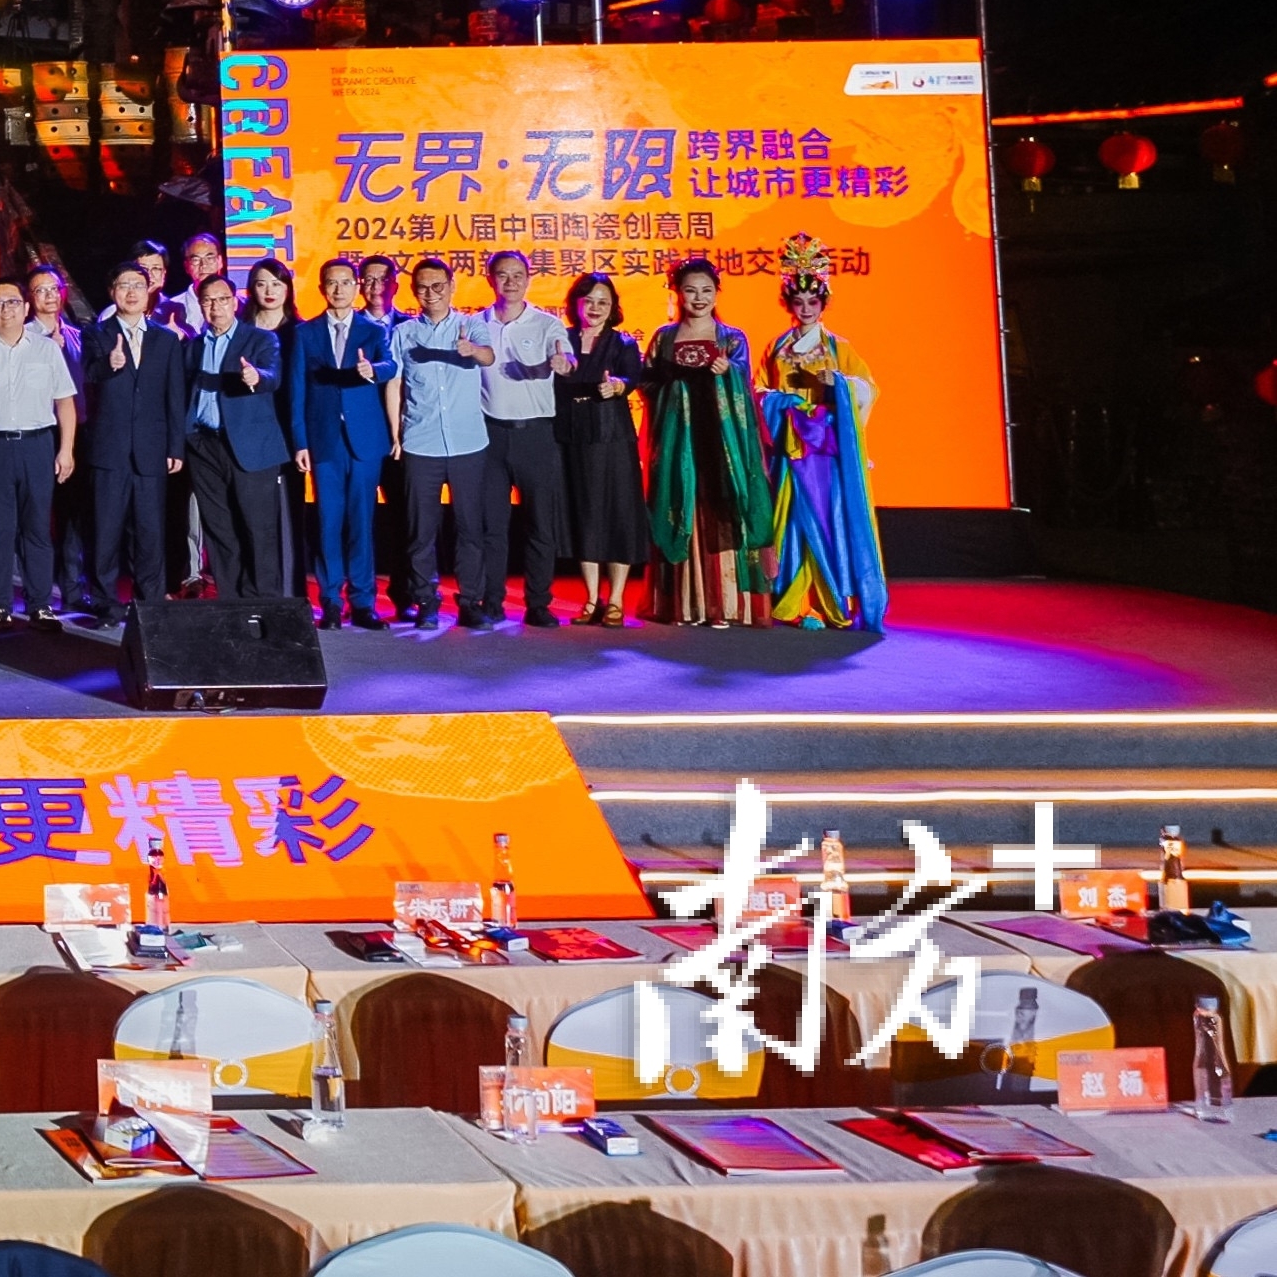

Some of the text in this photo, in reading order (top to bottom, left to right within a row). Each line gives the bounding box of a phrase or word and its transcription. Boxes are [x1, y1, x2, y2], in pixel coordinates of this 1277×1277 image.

[687, 128, 831, 162] 跨界融合
[687, 166, 910, 199] 让城市更精彩
[336, 212, 714, 241] 2024第八届中国陶瓷创意周
[1078, 886, 1127, 908] 刘杰
[1081, 1069, 1145, 1098] 赵杨
